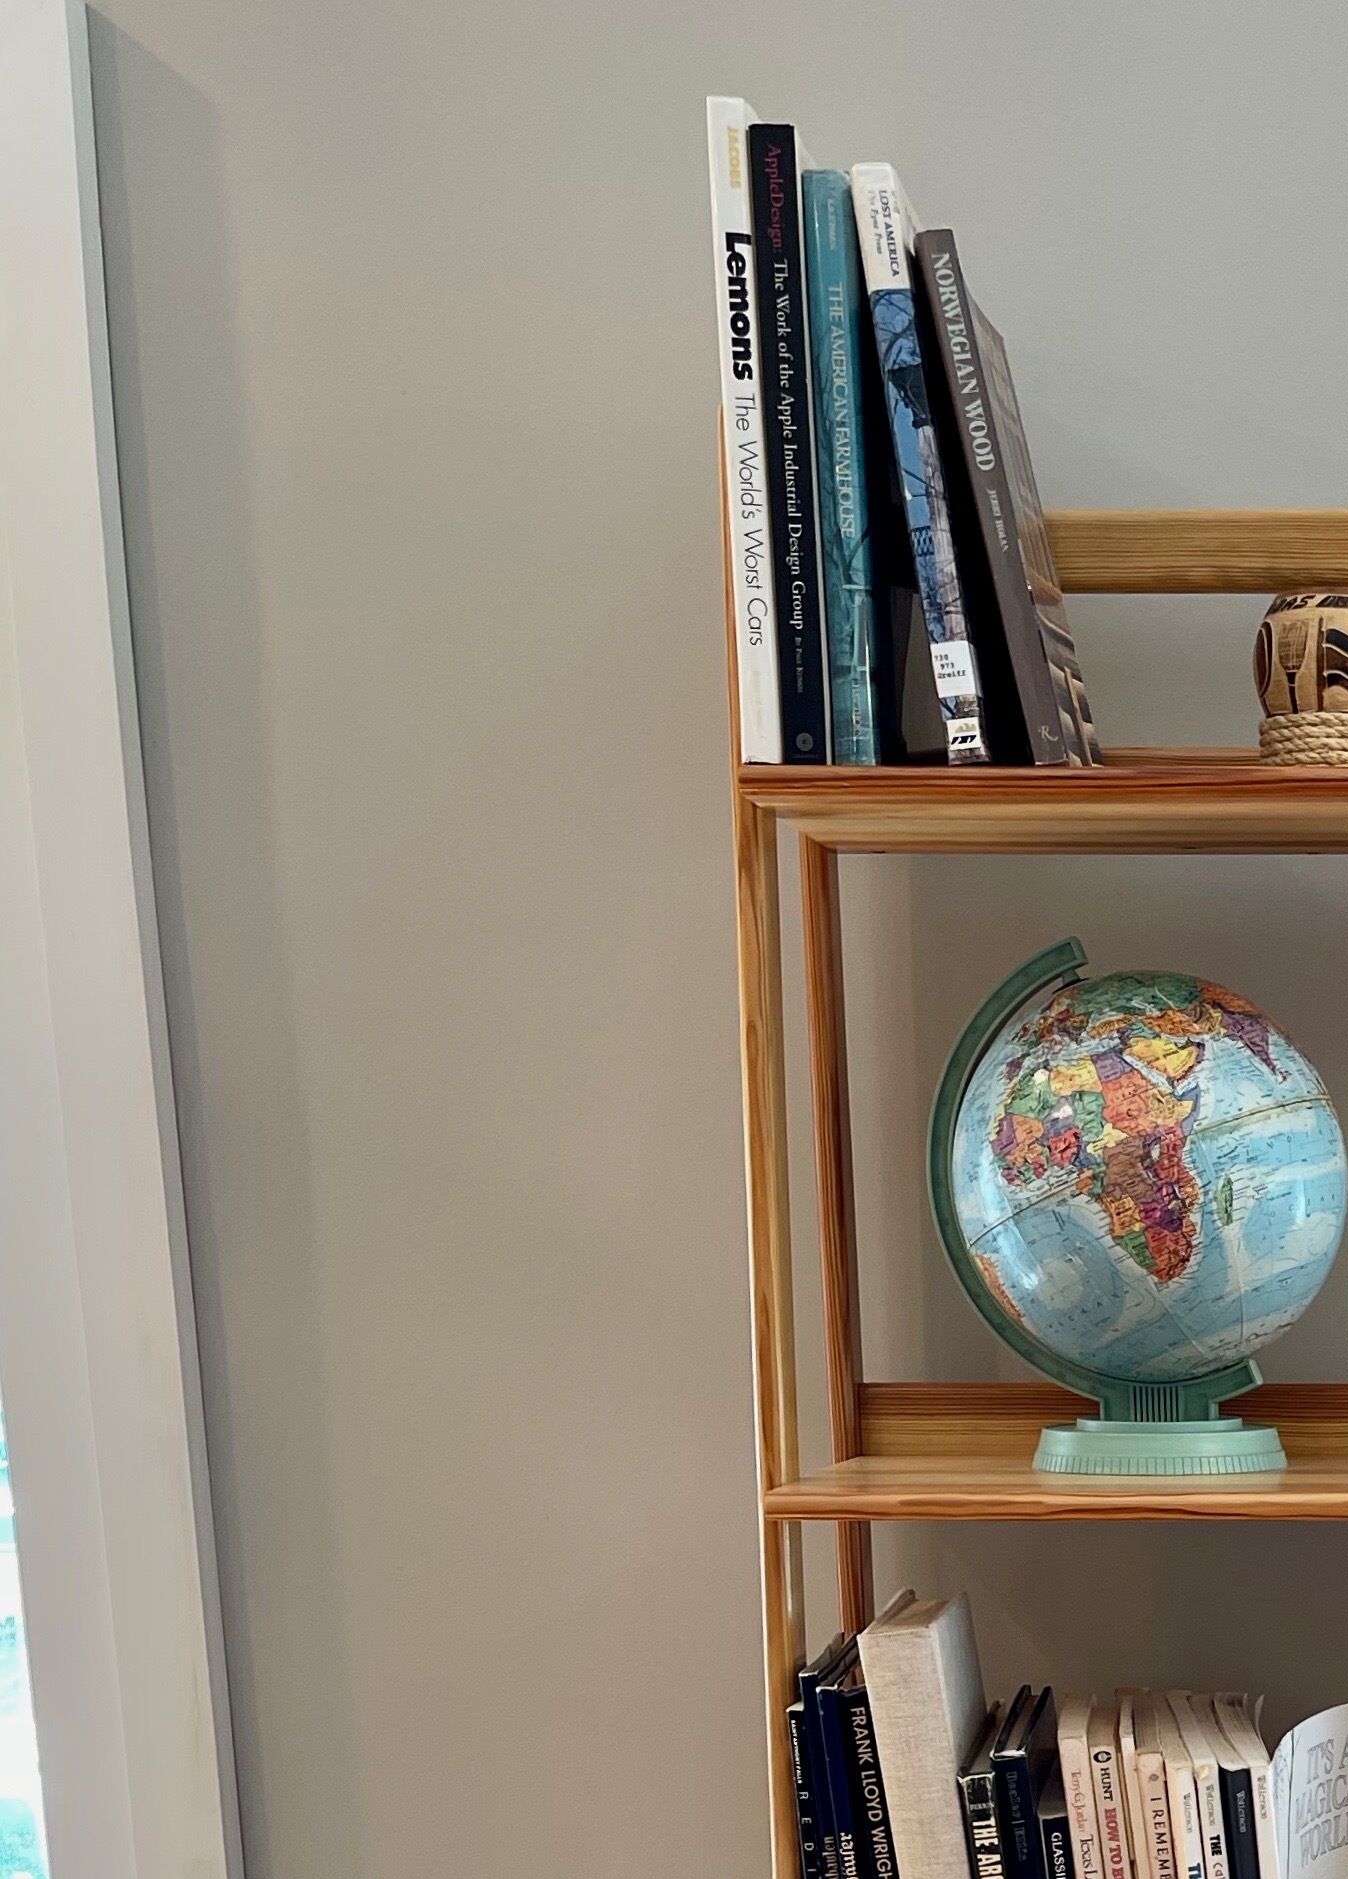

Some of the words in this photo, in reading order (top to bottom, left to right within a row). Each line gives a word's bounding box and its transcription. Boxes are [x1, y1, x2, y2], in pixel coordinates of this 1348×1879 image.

[726, 126, 741, 189] JACOBS
[879, 189, 892, 221] LOST
[885, 222, 900, 278] AMERICA
[773, 259, 789, 292] The
[725, 232, 753, 382] Lemons
[776, 295, 792, 340] Work
[828, 283, 844, 322] THE
[778, 343, 792, 363] of
[830, 324, 850, 424] AMERICAN
[932, 251, 978, 395] NORWEGIAN
[963, 401, 995, 472] WOOD
[779, 365, 793, 390] the
[735, 393, 754, 431] The
[778, 392, 795, 441] Apple
[737, 440, 763, 520] World's
[783, 444, 801, 518] Industrial
[835, 427, 857, 538] FARMHOUSE
[786, 524, 803, 575] Design
[993, 516, 1009, 553] HOLAN
[744, 529, 764, 590] Worst
[746, 597, 768, 647] Cars
[788, 581, 807, 631] Group
[850, 1706, 873, 1765] FRANK
[1100, 1767, 1113, 1801] HUNT
[1307, 1738, 1335, 1785] IT'S
[861, 1769, 883, 1823] LLOYD
[972, 1818, 996, 1847] THE
[1104, 1808, 1119, 1842] HOW
[1209, 1834, 1222, 1857] THE
[1079, 1833, 1095, 1867] Texas
[1109, 1845, 1121, 1865] TO
